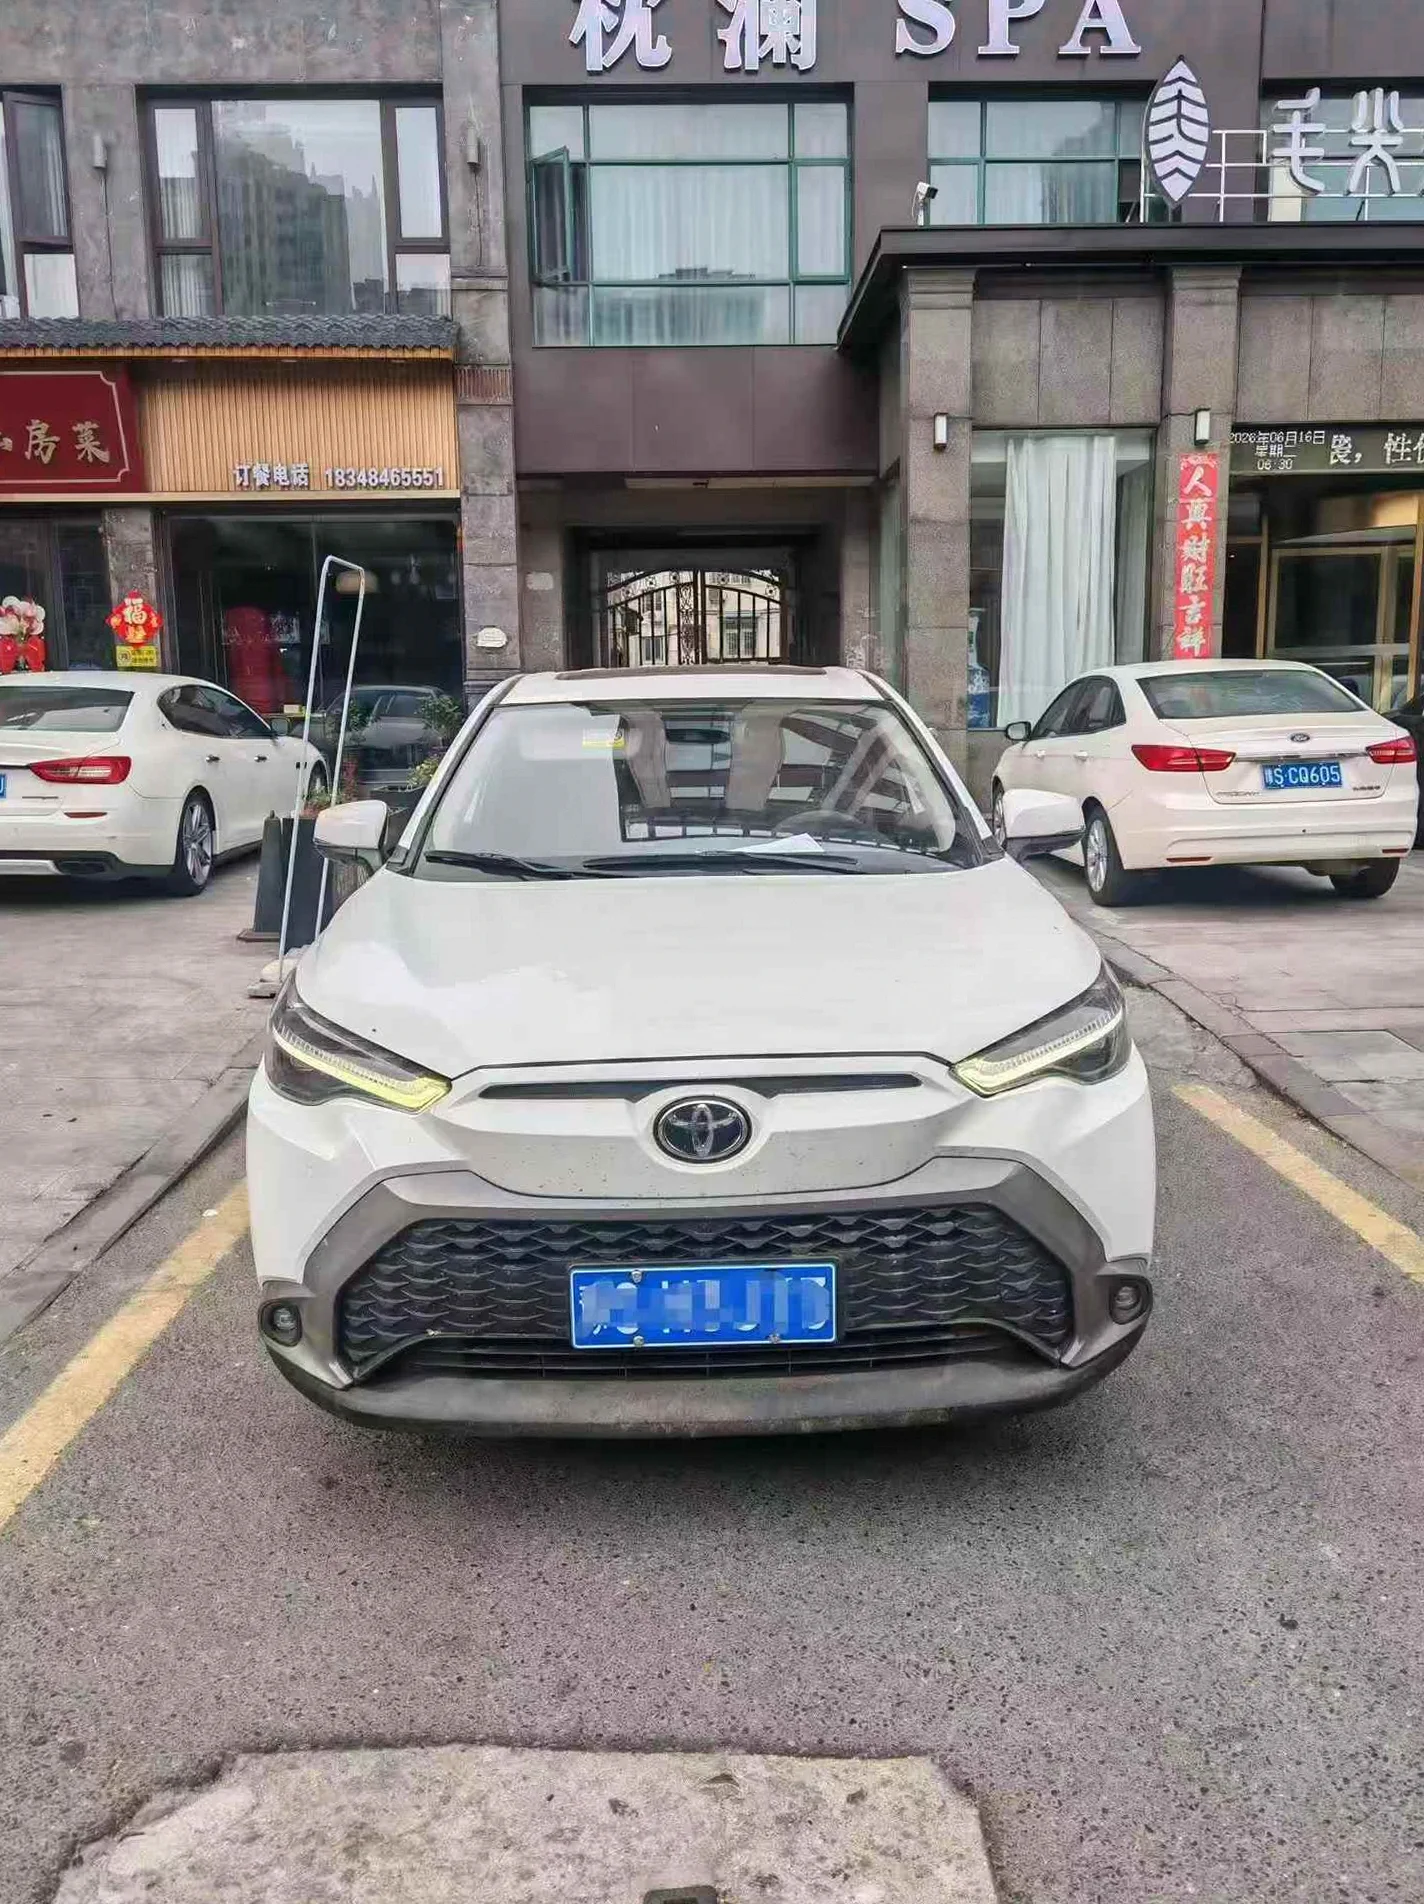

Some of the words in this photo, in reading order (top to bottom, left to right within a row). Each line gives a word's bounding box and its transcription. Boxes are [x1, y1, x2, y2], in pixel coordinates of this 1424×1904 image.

[895, 0, 1142, 56] SPA
[1272, 86, 1424, 194] 毛尖
[233, 462, 309, 488] 订餐电话
[325, 466, 444, 488] 18348465551
[123, 597, 147, 625] 福
